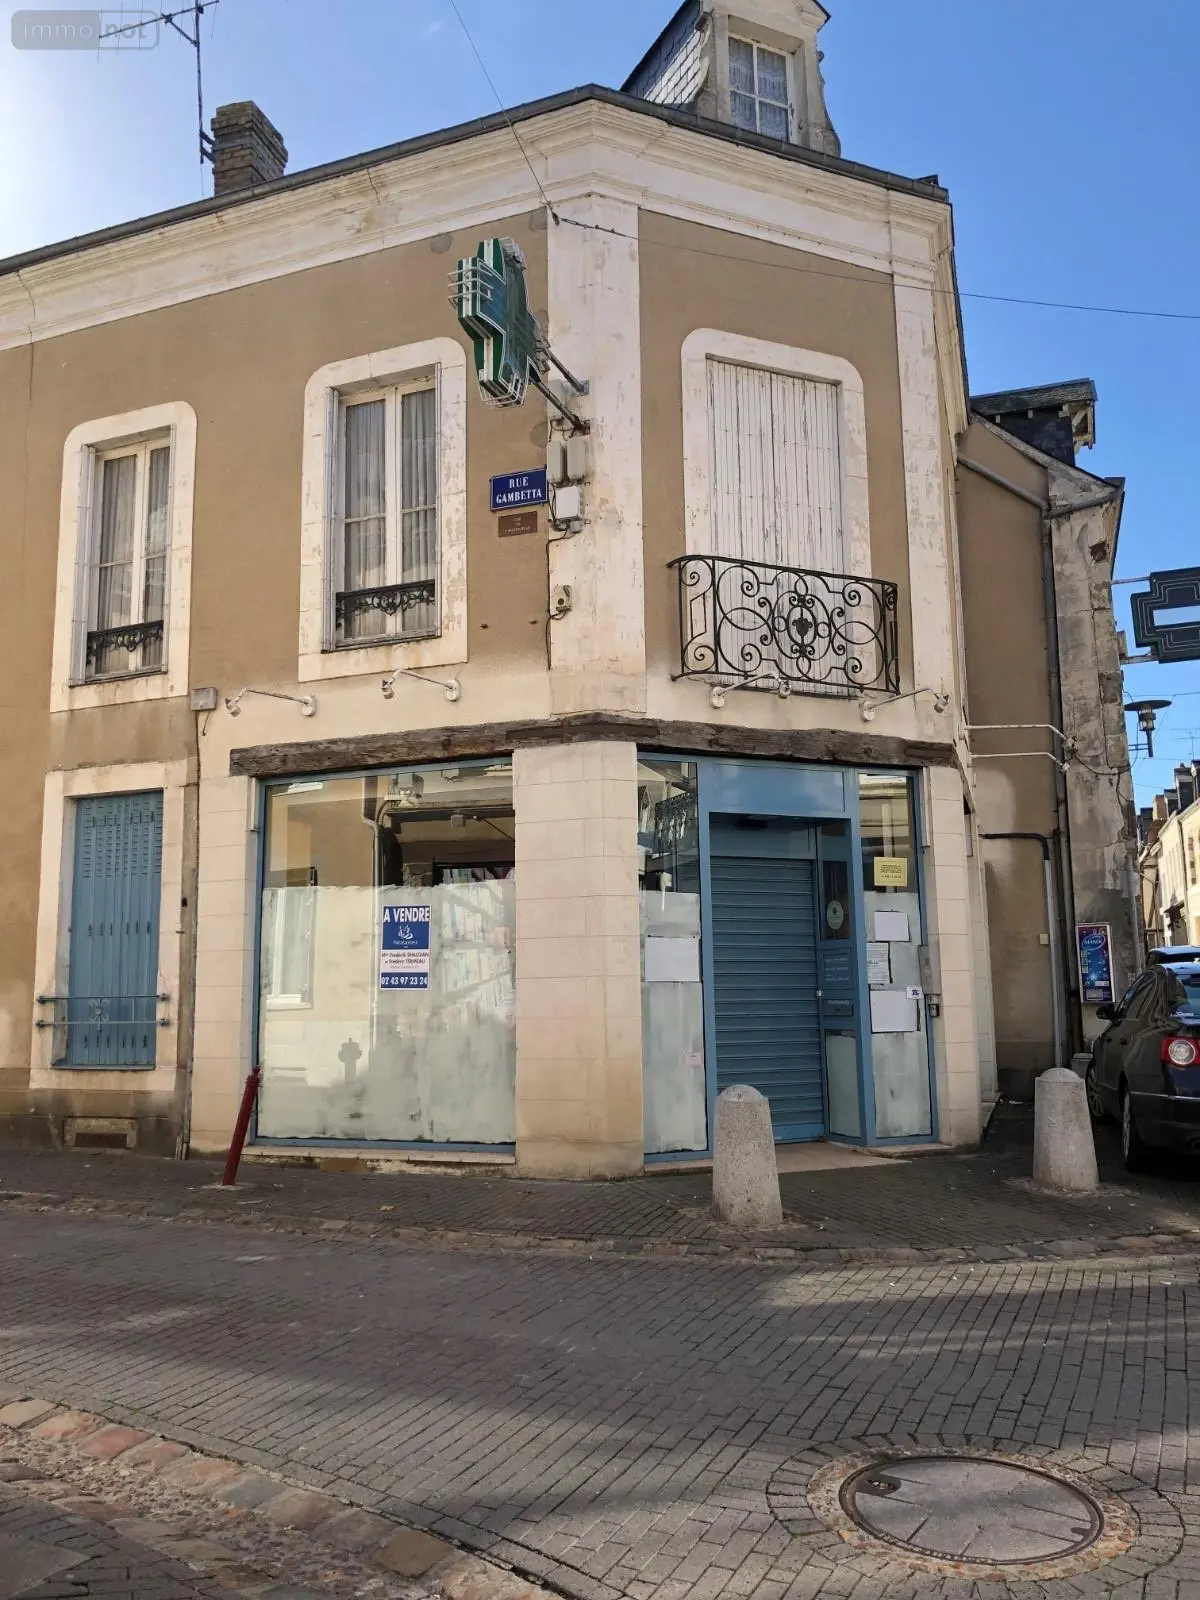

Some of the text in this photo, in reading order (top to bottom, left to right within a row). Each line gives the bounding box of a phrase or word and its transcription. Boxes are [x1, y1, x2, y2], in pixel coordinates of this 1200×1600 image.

[509, 476, 529, 488] RUE
[496, 489, 542, 504] GAMBETTA
[383, 907, 430, 922] A VENDRE
[381, 977, 428, 985] 02 43 97 23 24
